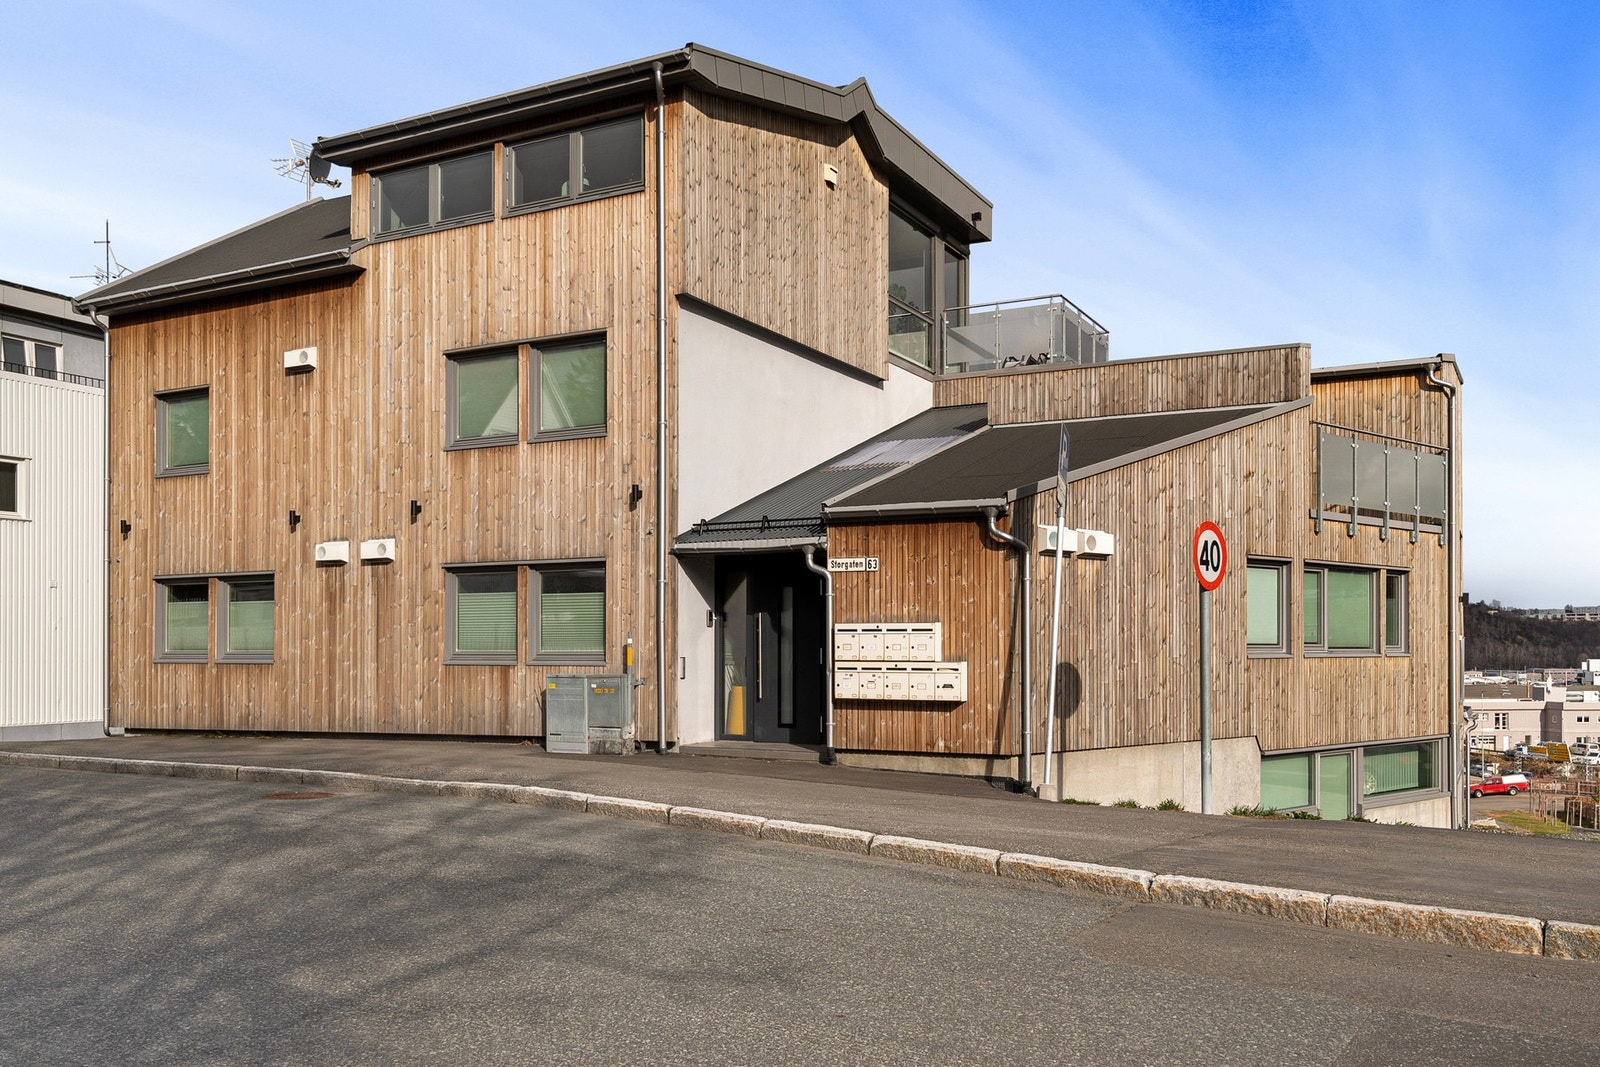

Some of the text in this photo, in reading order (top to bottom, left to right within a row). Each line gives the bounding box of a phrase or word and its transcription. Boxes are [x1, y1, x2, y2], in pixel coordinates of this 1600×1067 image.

[1061, 432, 1068, 470] P
[831, 559, 878, 570] Storgaten 63
[1200, 540, 1220, 572] 40
